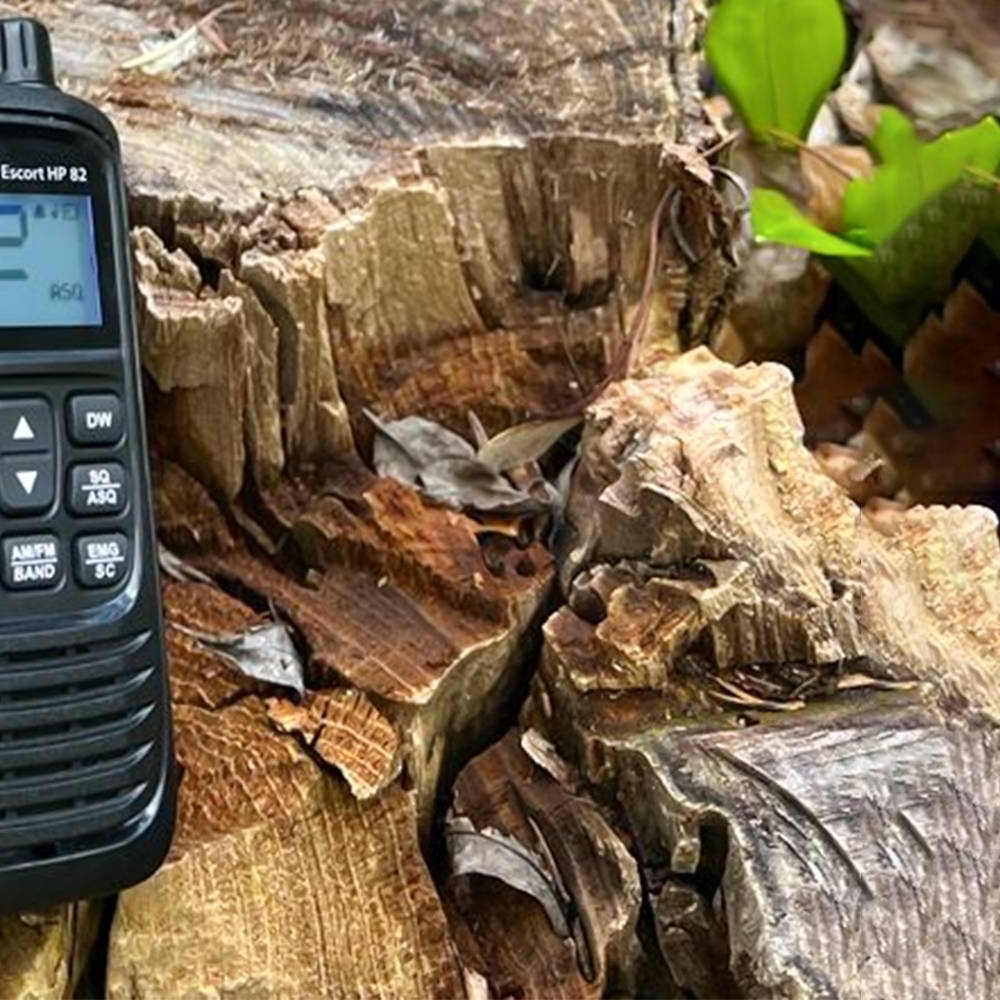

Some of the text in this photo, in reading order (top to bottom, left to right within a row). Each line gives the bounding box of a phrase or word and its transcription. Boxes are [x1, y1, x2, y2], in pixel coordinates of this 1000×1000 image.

[0, 164, 45, 181] Escort
[46, 166, 67, 182] HP
[69, 166, 87, 182] 82
[86, 412, 112, 429] DW
[88, 470, 111, 484] SQ
[87, 491, 118, 505] ASQ
[11, 542, 55, 561] AM/FM
[87, 542, 120, 558] EMG
[13, 564, 56, 582] BAND
[95, 564, 116, 579] SC
